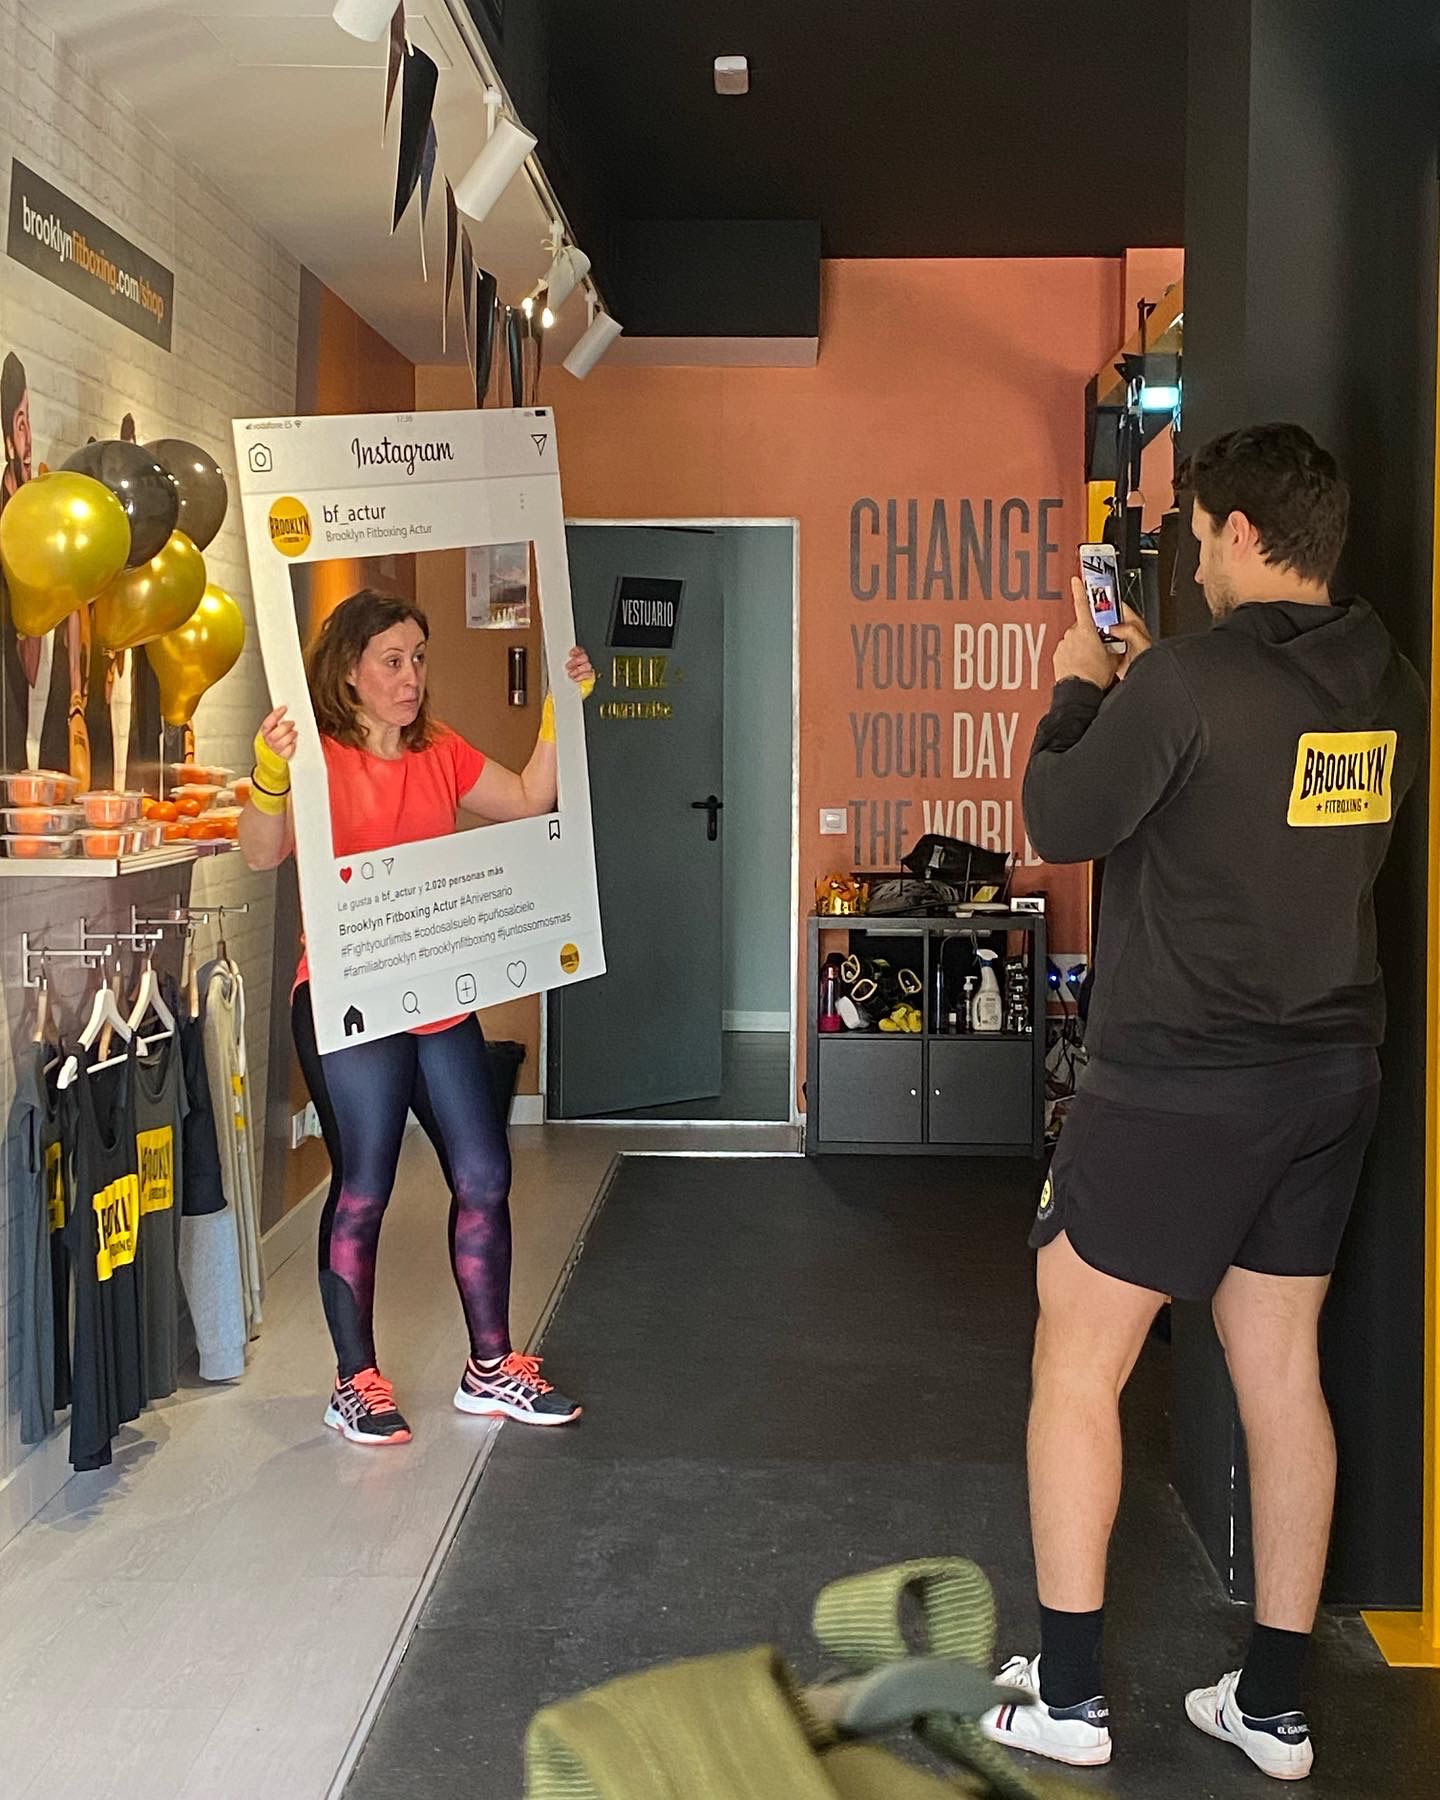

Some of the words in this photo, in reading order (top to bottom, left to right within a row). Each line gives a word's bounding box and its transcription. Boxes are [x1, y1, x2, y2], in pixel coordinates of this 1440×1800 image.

[22, 195, 164, 323] brooklynfitboxing.com/shop
[351, 436, 454, 475] Instagram
[268, 513, 311, 539] BROOKLYN
[322, 504, 386, 526] bf_actur
[326, 528, 365, 543] Brooklyn
[367, 525, 408, 539] Fitboxing
[409, 524, 432, 535] Actur
[849, 496, 1064, 602] CHANGE
[622, 598, 674, 628] VESTUARIO
[849, 622, 942, 691] YOUR
[953, 622, 1047, 691] BODY
[849, 712, 942, 780] YOUR
[952, 712, 1019, 779] DAY
[1300, 743, 1388, 800] BROOKLYN
[1324, 798, 1362, 814] FITBOXING
[848, 799, 913, 866] THE
[337, 901, 348, 912] Le
[350, 896, 373, 912] gusta
[381, 886, 417, 903] bf_actur
[424, 877, 447, 892] 2.020
[448, 870, 486, 889] personas
[338, 916, 384, 937] Brooklyn
[386, 904, 431, 926] Fitboxing
[432, 898, 458, 915] Actur
